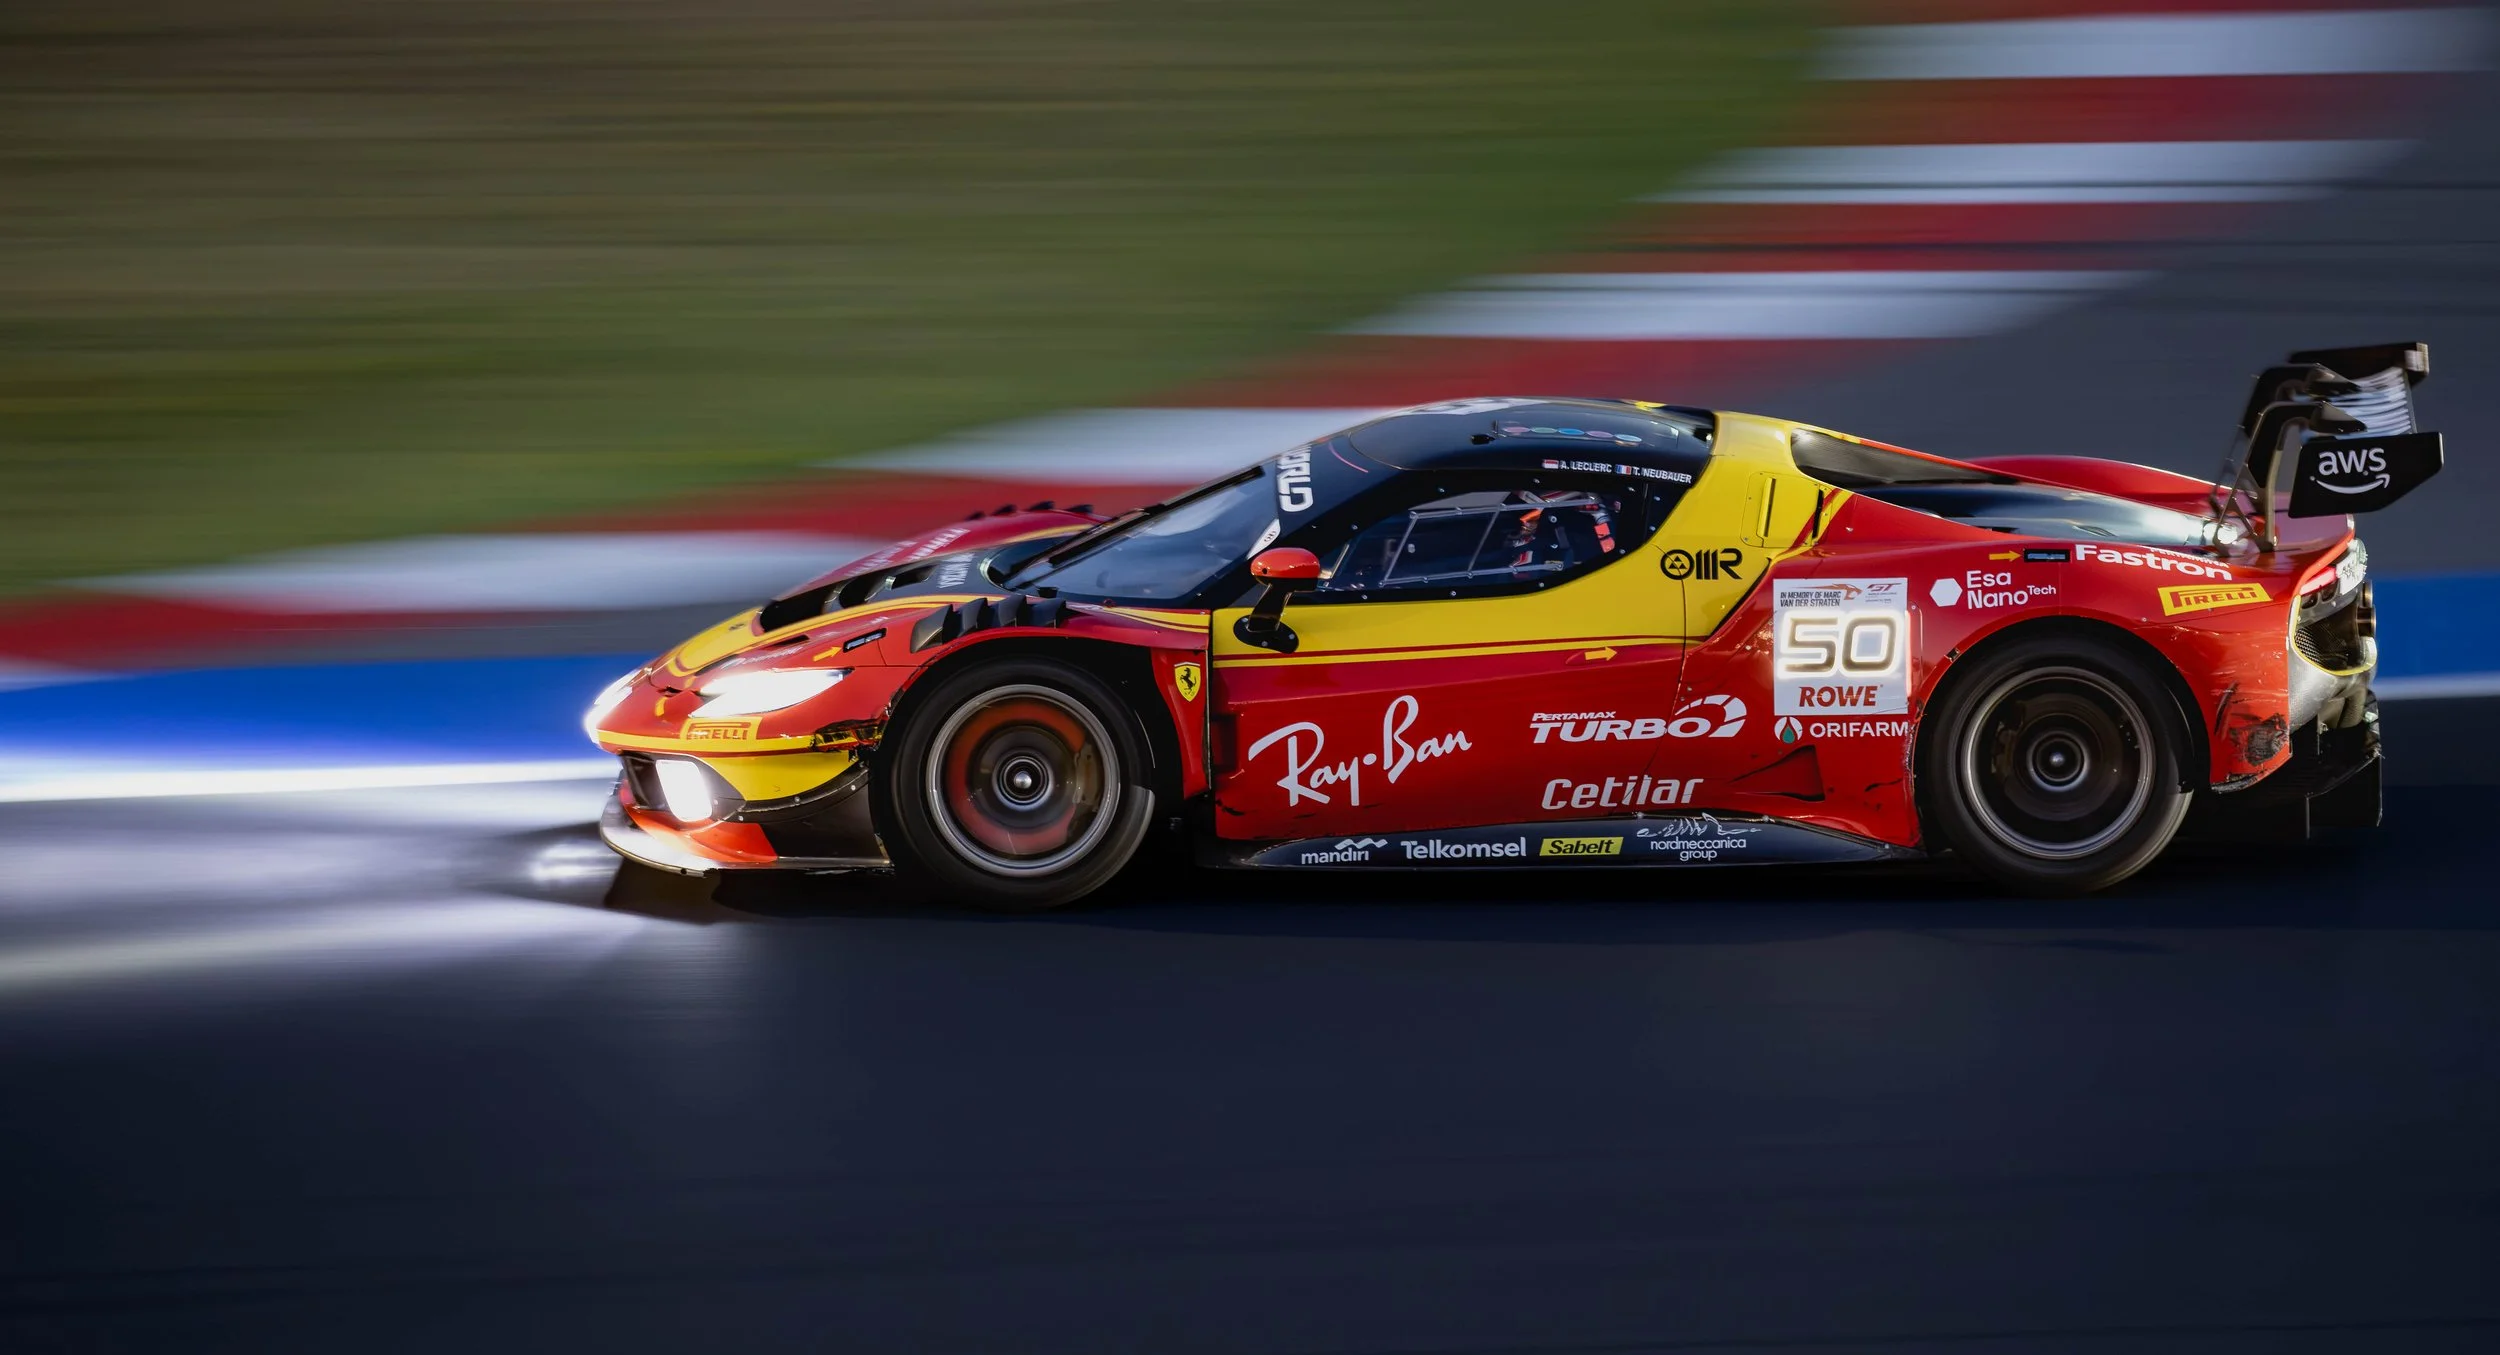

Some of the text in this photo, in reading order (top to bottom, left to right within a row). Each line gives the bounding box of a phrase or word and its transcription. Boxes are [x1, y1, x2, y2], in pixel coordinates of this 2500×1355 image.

[1560, 460, 1612, 473] A. LECLERC
[2318, 447, 2387, 476] aws
[1633, 466, 1692, 484] T. NEUBAUER
[2075, 544, 2232, 581] Fastron
[1966, 570, 2012, 588] Esa
[1780, 599, 1841, 607] VAN DER STRATEN
[2169, 586, 2257, 609] PIRELLI
[1781, 613, 1899, 676] 50
[1799, 686, 1877, 707] ROWE
[1531, 711, 1617, 722] PERTAMAX
[1810, 722, 1909, 738] ORIFARM
[1541, 774, 1704, 810] Cetilar
[1400, 836, 1527, 859] Telkomsel
[1549, 839, 1615, 854] Sabelt
[1650, 836, 1748, 850] nordmeccanica
[1301, 848, 1370, 864] mandiri
[1679, 850, 1718, 862] group
